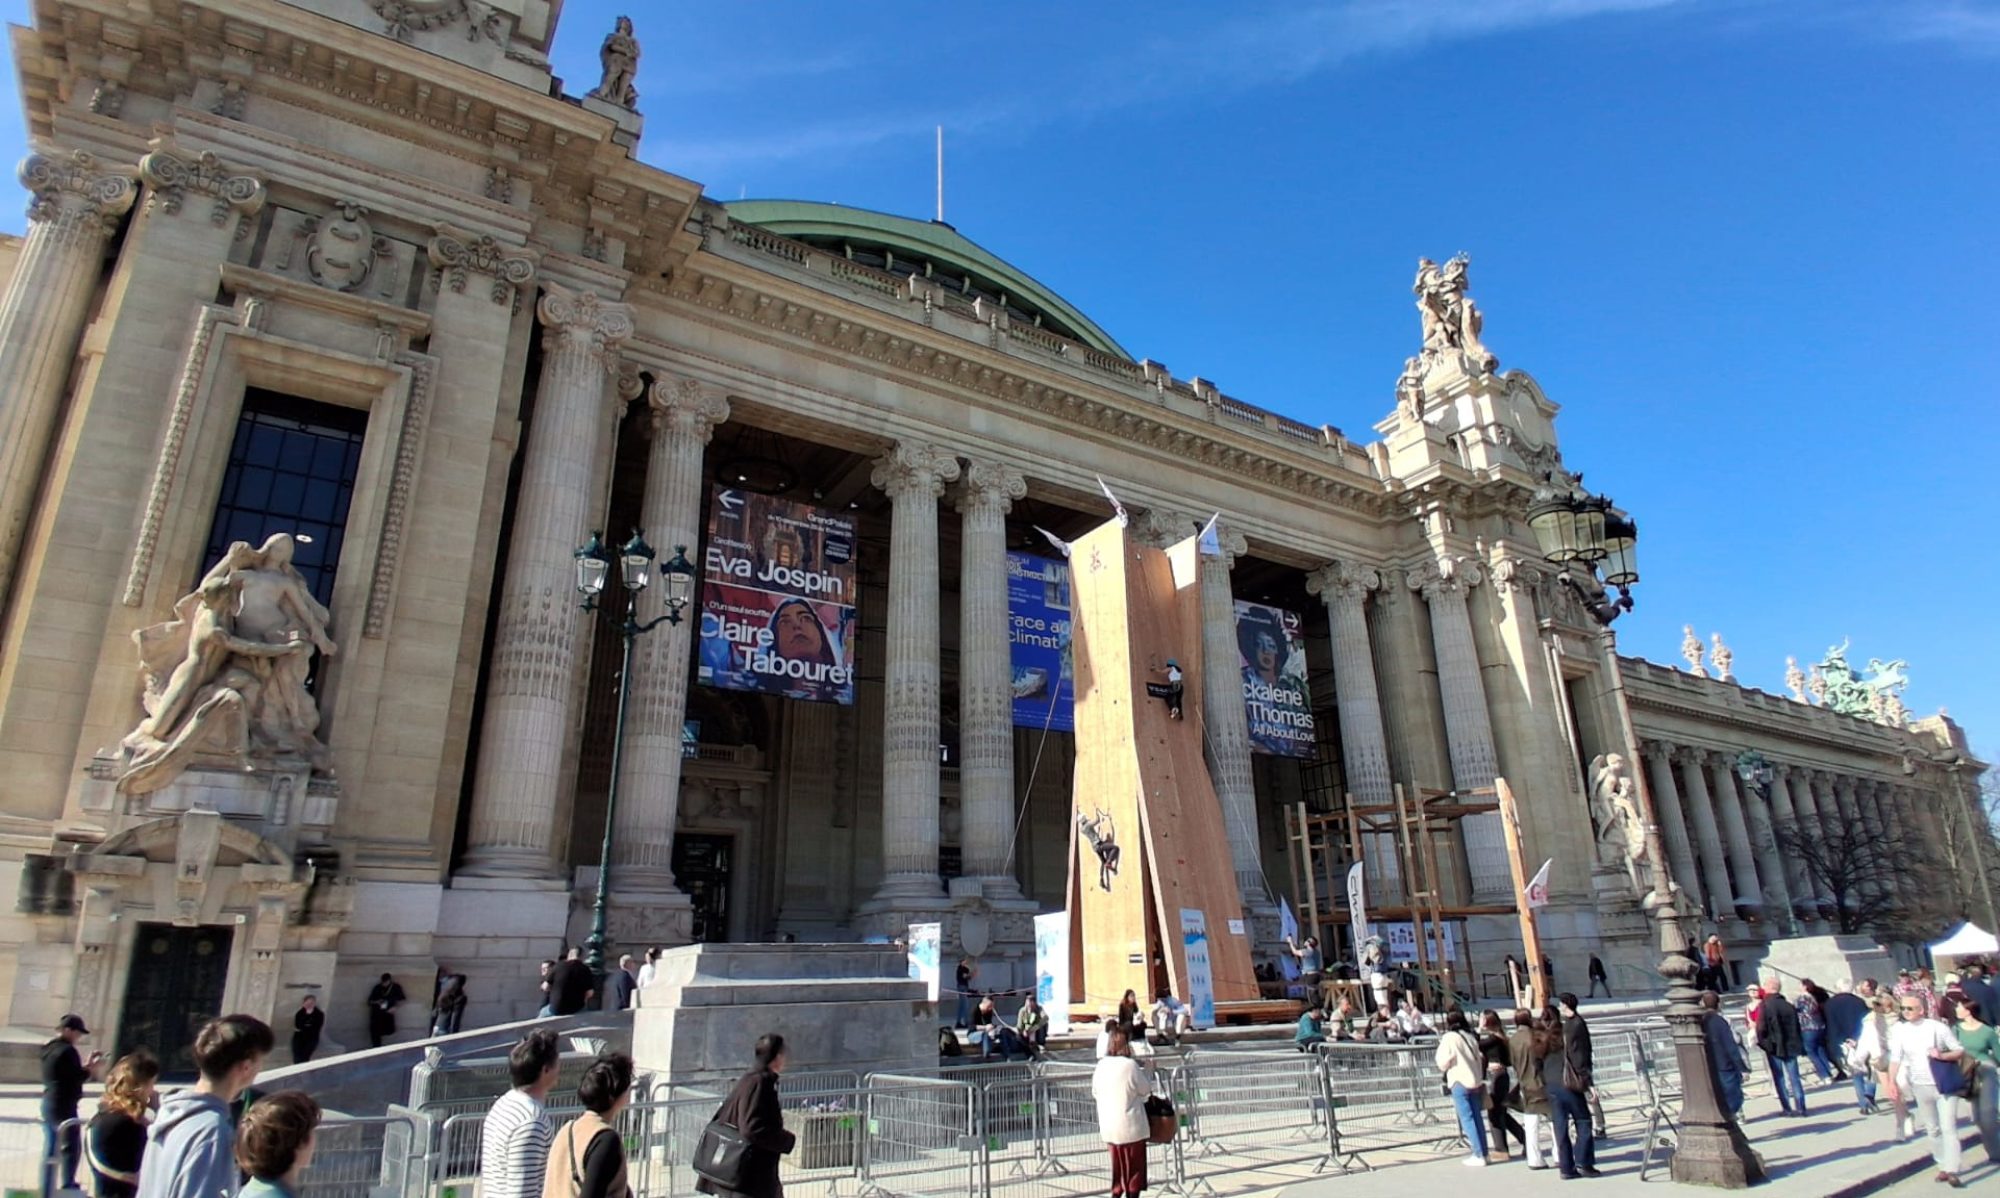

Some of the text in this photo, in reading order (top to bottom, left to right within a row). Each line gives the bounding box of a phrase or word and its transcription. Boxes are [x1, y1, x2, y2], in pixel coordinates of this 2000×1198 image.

[705, 547, 842, 595] Eva Jospin
[700, 612, 775, 647] Claire
[1009, 628, 1060, 649] climat
[738, 645, 853, 685] Tabouret
[1242, 680, 1303, 706] ckalene
[1247, 701, 1314, 729] Thomas
[1267, 726, 1294, 739] About
[1295, 729, 1316, 742] Love
